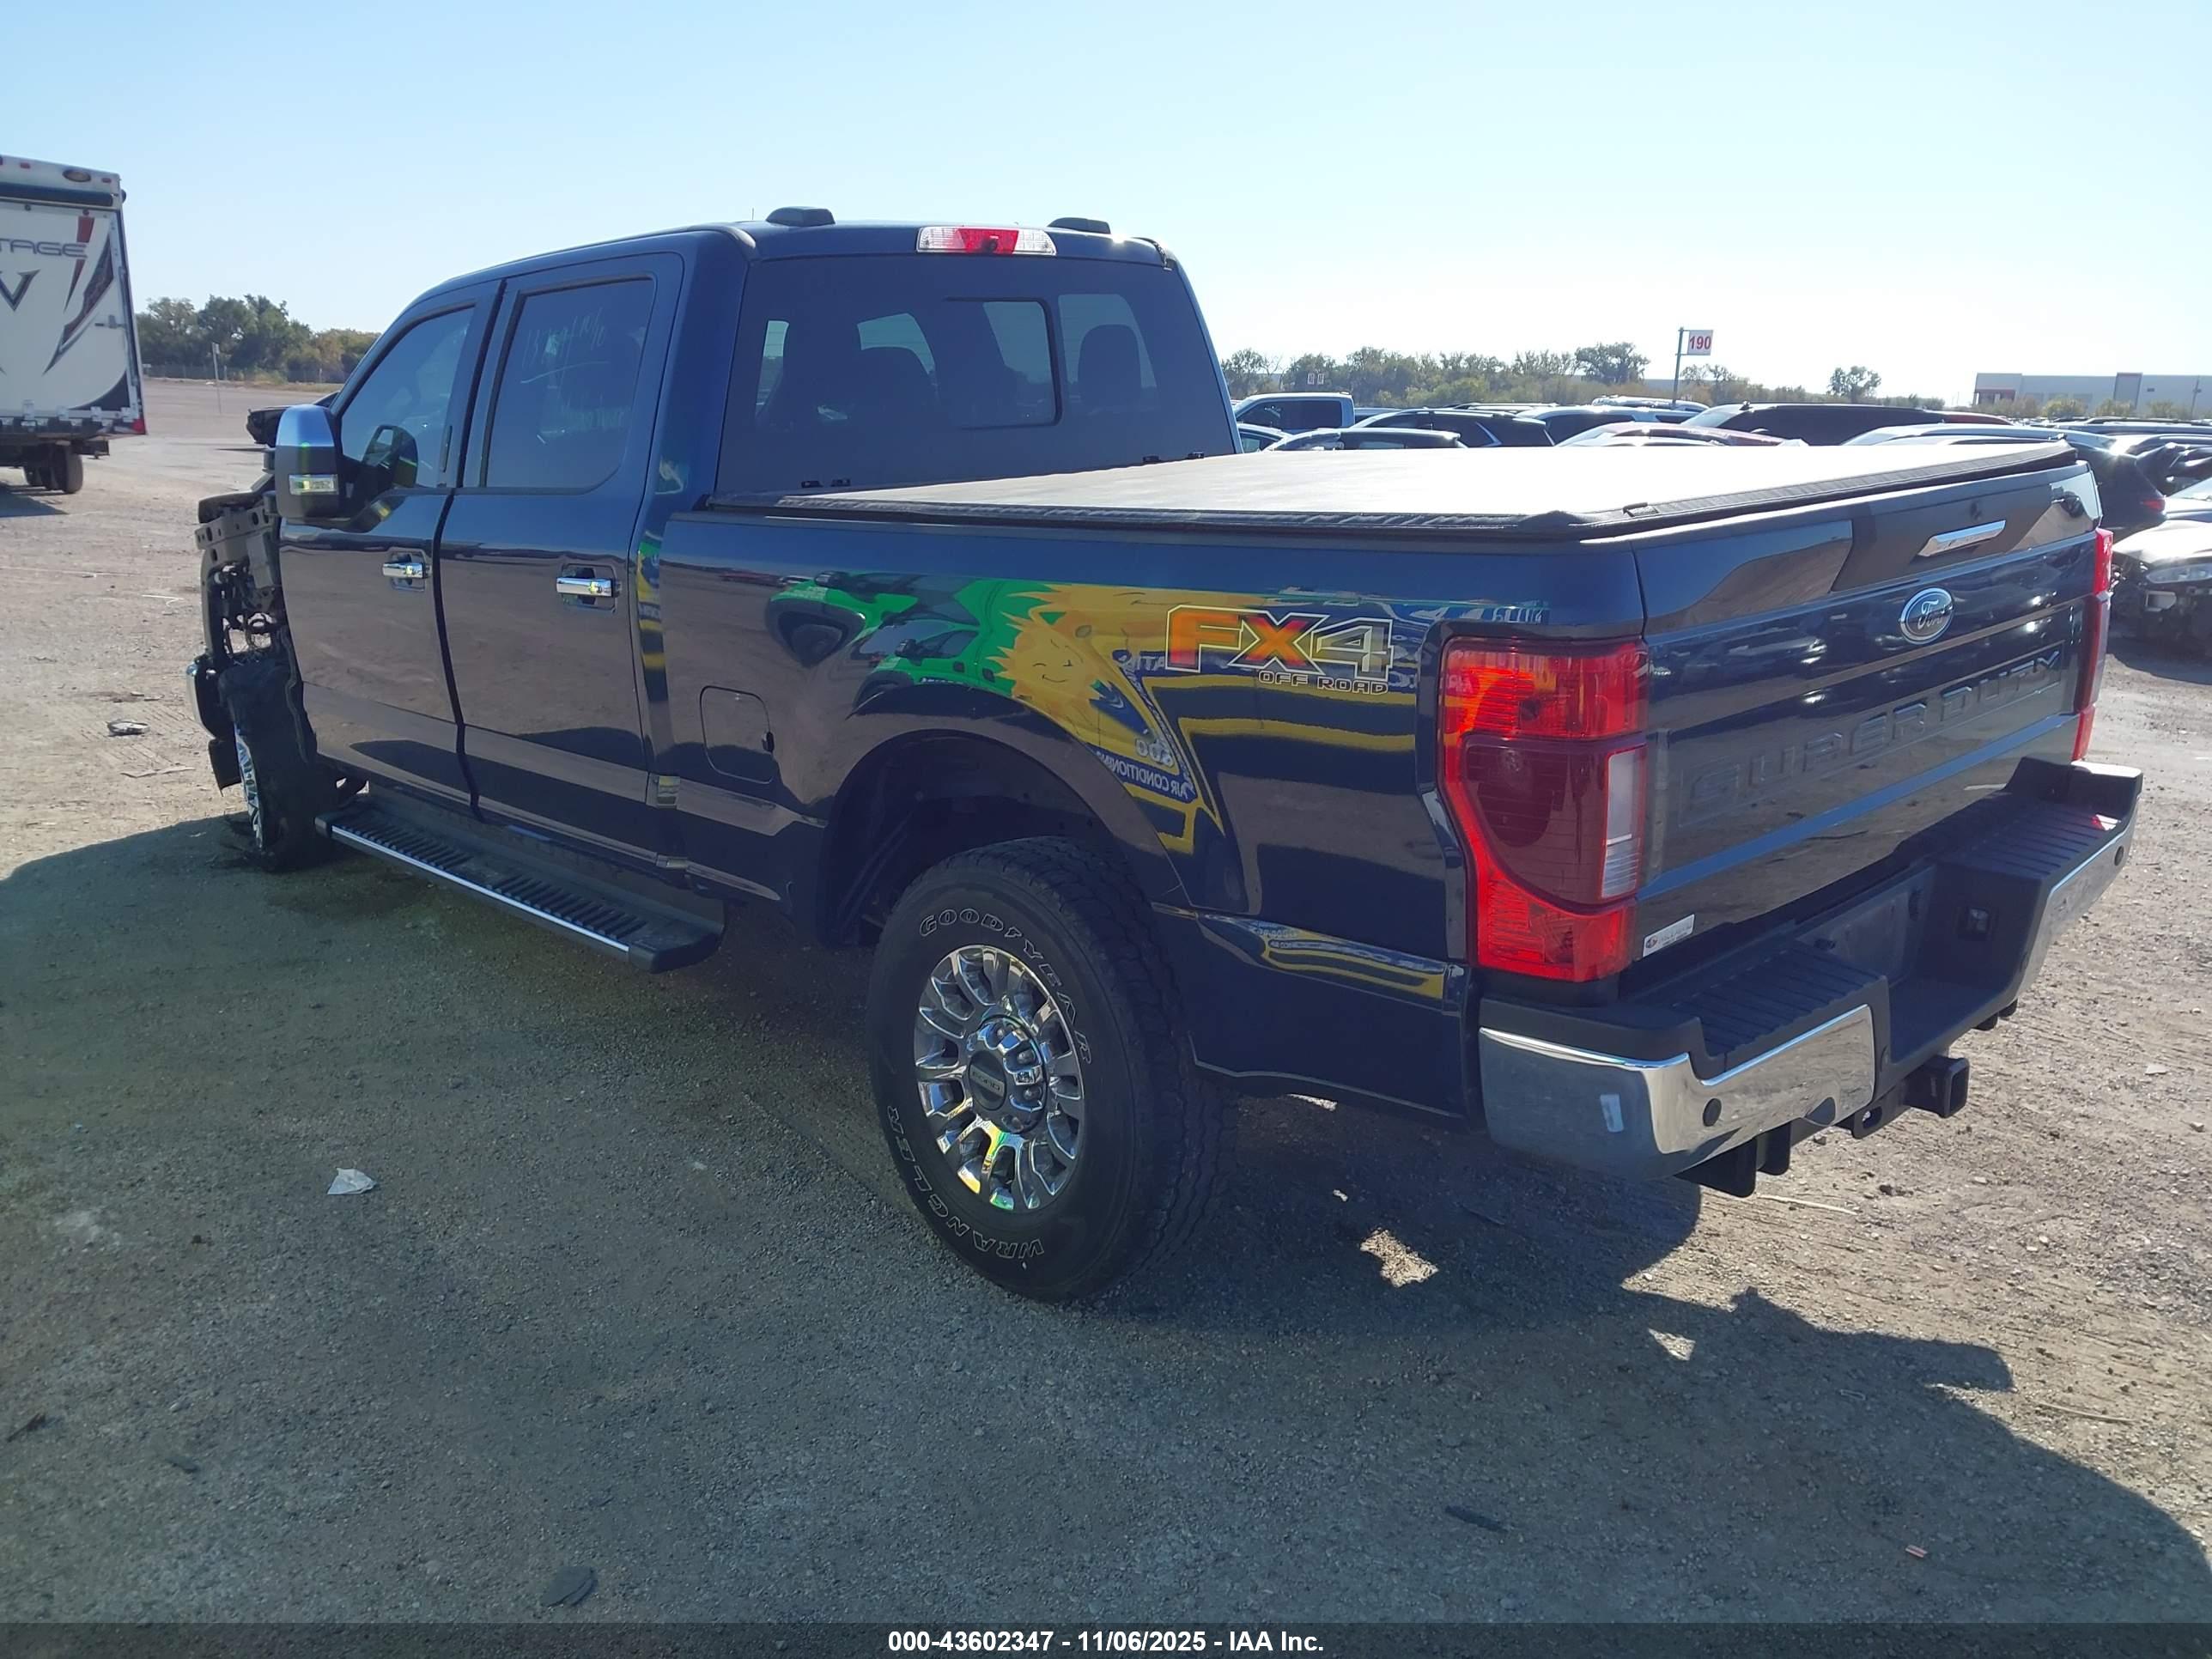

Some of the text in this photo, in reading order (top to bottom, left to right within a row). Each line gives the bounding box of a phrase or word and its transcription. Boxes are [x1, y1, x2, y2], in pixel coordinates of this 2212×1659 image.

[1690, 336, 1711, 350] 190
[1165, 604, 1394, 681] FX4
[1917, 599, 1950, 630] Ford
[1258, 670, 1389, 696] OFF ROAD
[1689, 650, 2060, 807] SUPER DUTY
[920, 908, 1092, 1066] GOODYEAR
[887, 1105, 1044, 1259] WRANGLER
